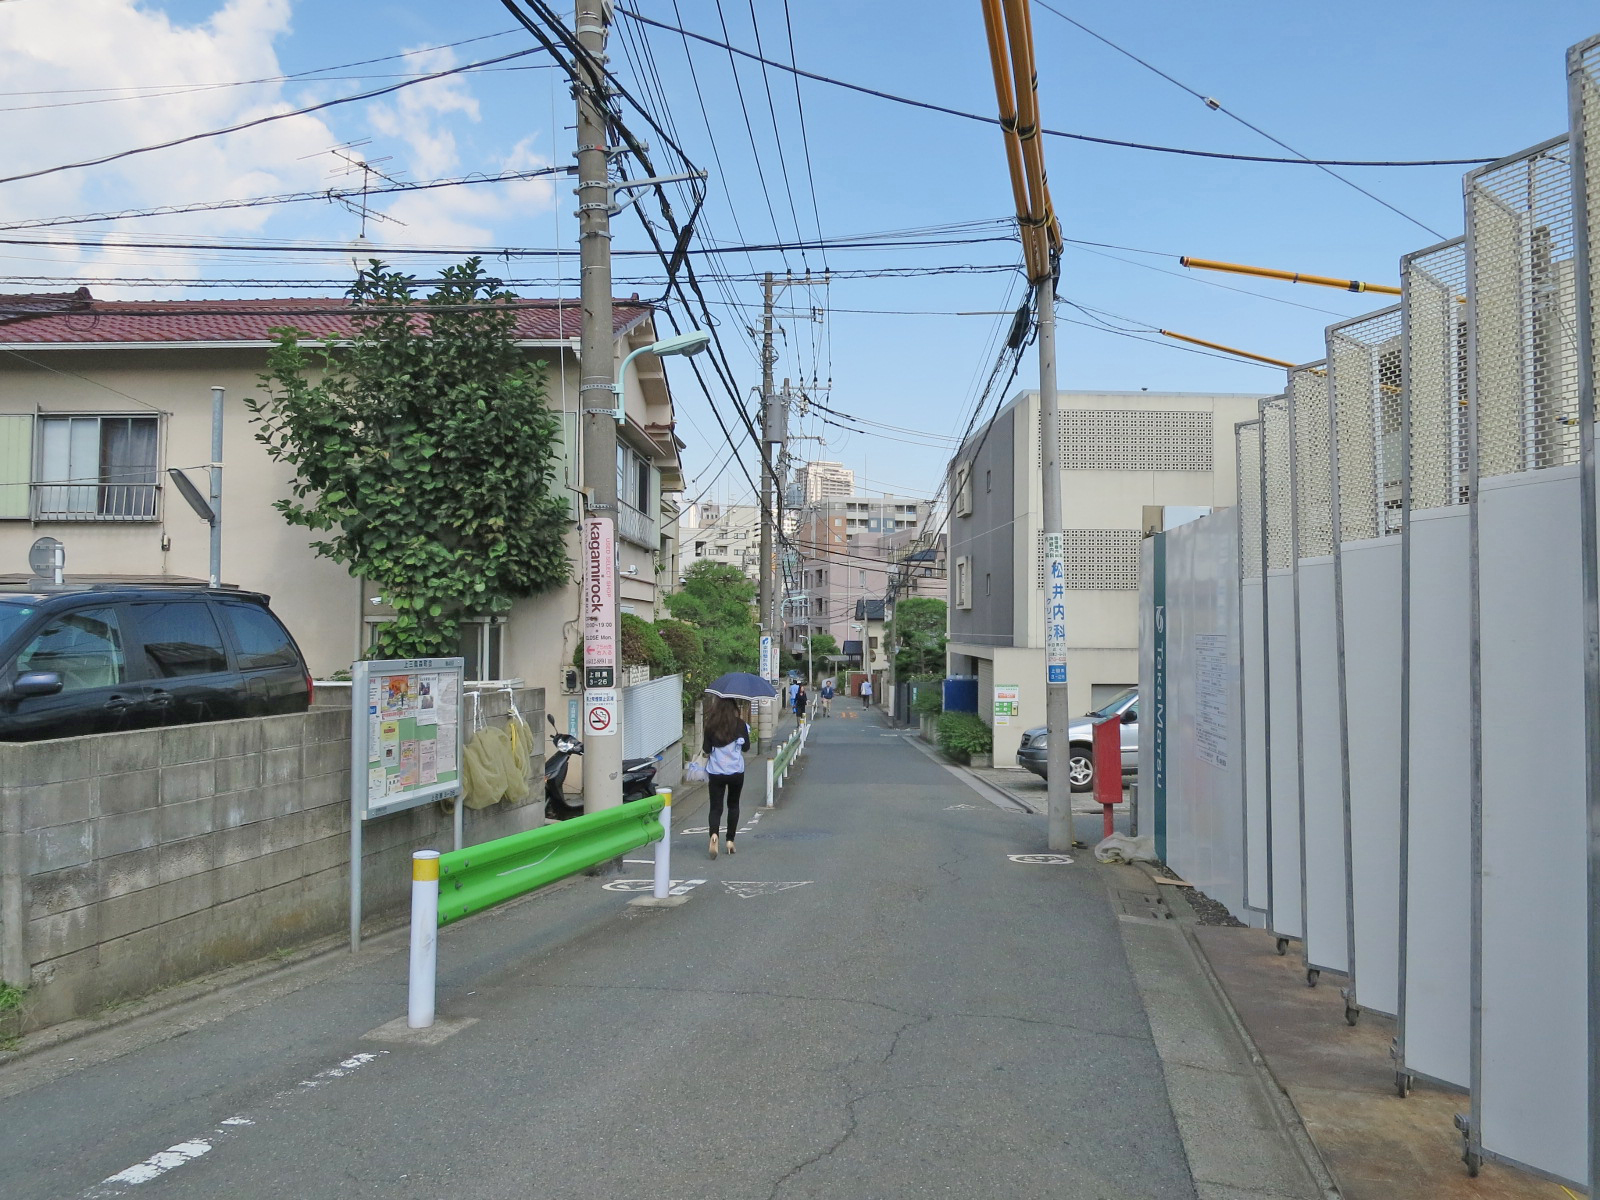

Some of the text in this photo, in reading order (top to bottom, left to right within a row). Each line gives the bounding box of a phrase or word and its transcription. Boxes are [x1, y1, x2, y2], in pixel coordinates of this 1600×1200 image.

[589, 522, 604, 614] kagamirock
[1051, 560, 1065, 641] 松井内科
